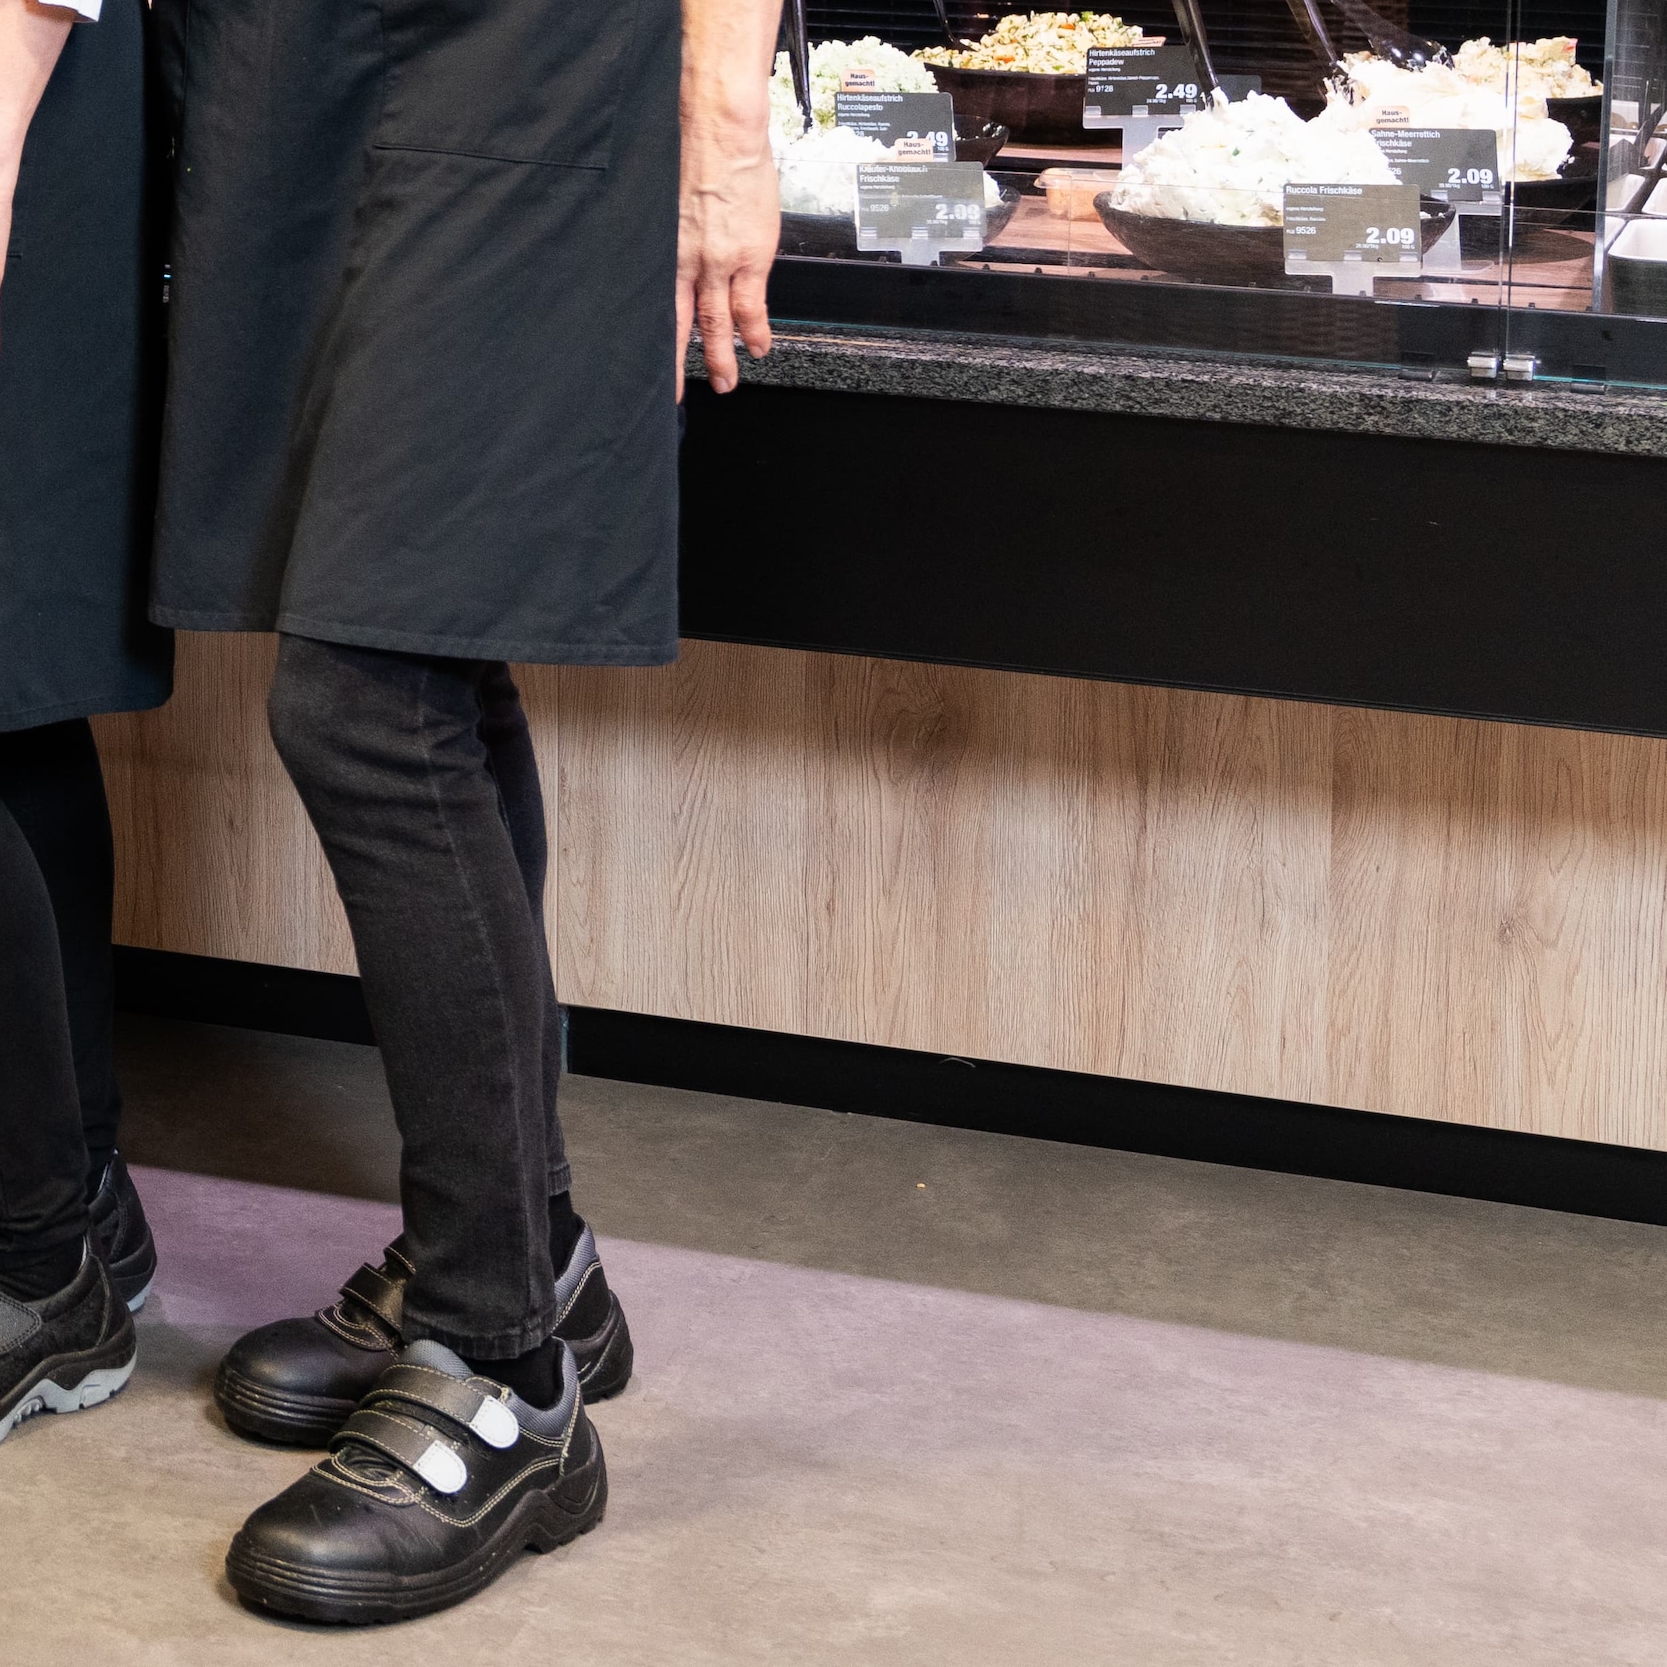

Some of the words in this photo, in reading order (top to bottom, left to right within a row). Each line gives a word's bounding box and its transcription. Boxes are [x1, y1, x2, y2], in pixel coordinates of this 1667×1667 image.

[1089, 49, 1155, 57] Hirtenkäseaufstrich
[1089, 58, 1124, 67] Peppadew
[845, 79, 875, 87] gemacht!
[1156, 83, 1198, 99] 2.49
[837, 94, 903, 103] Hirtenkäseaufstrich
[837, 103, 883, 112] Ruccolapesto
[1371, 130, 1441, 139] Sahne-Meerrettich
[1376, 139, 1412, 147] rischkäse
[860, 174, 900, 183] Frischkäse
[1448, 168, 1493, 184] 2.09
[1286, 186, 1318, 194] Ruccola
[1319, 186, 1363, 195] Frischkäse
[1295, 226, 1316, 235] 9526
[1366, 227, 1415, 245] 2.09
